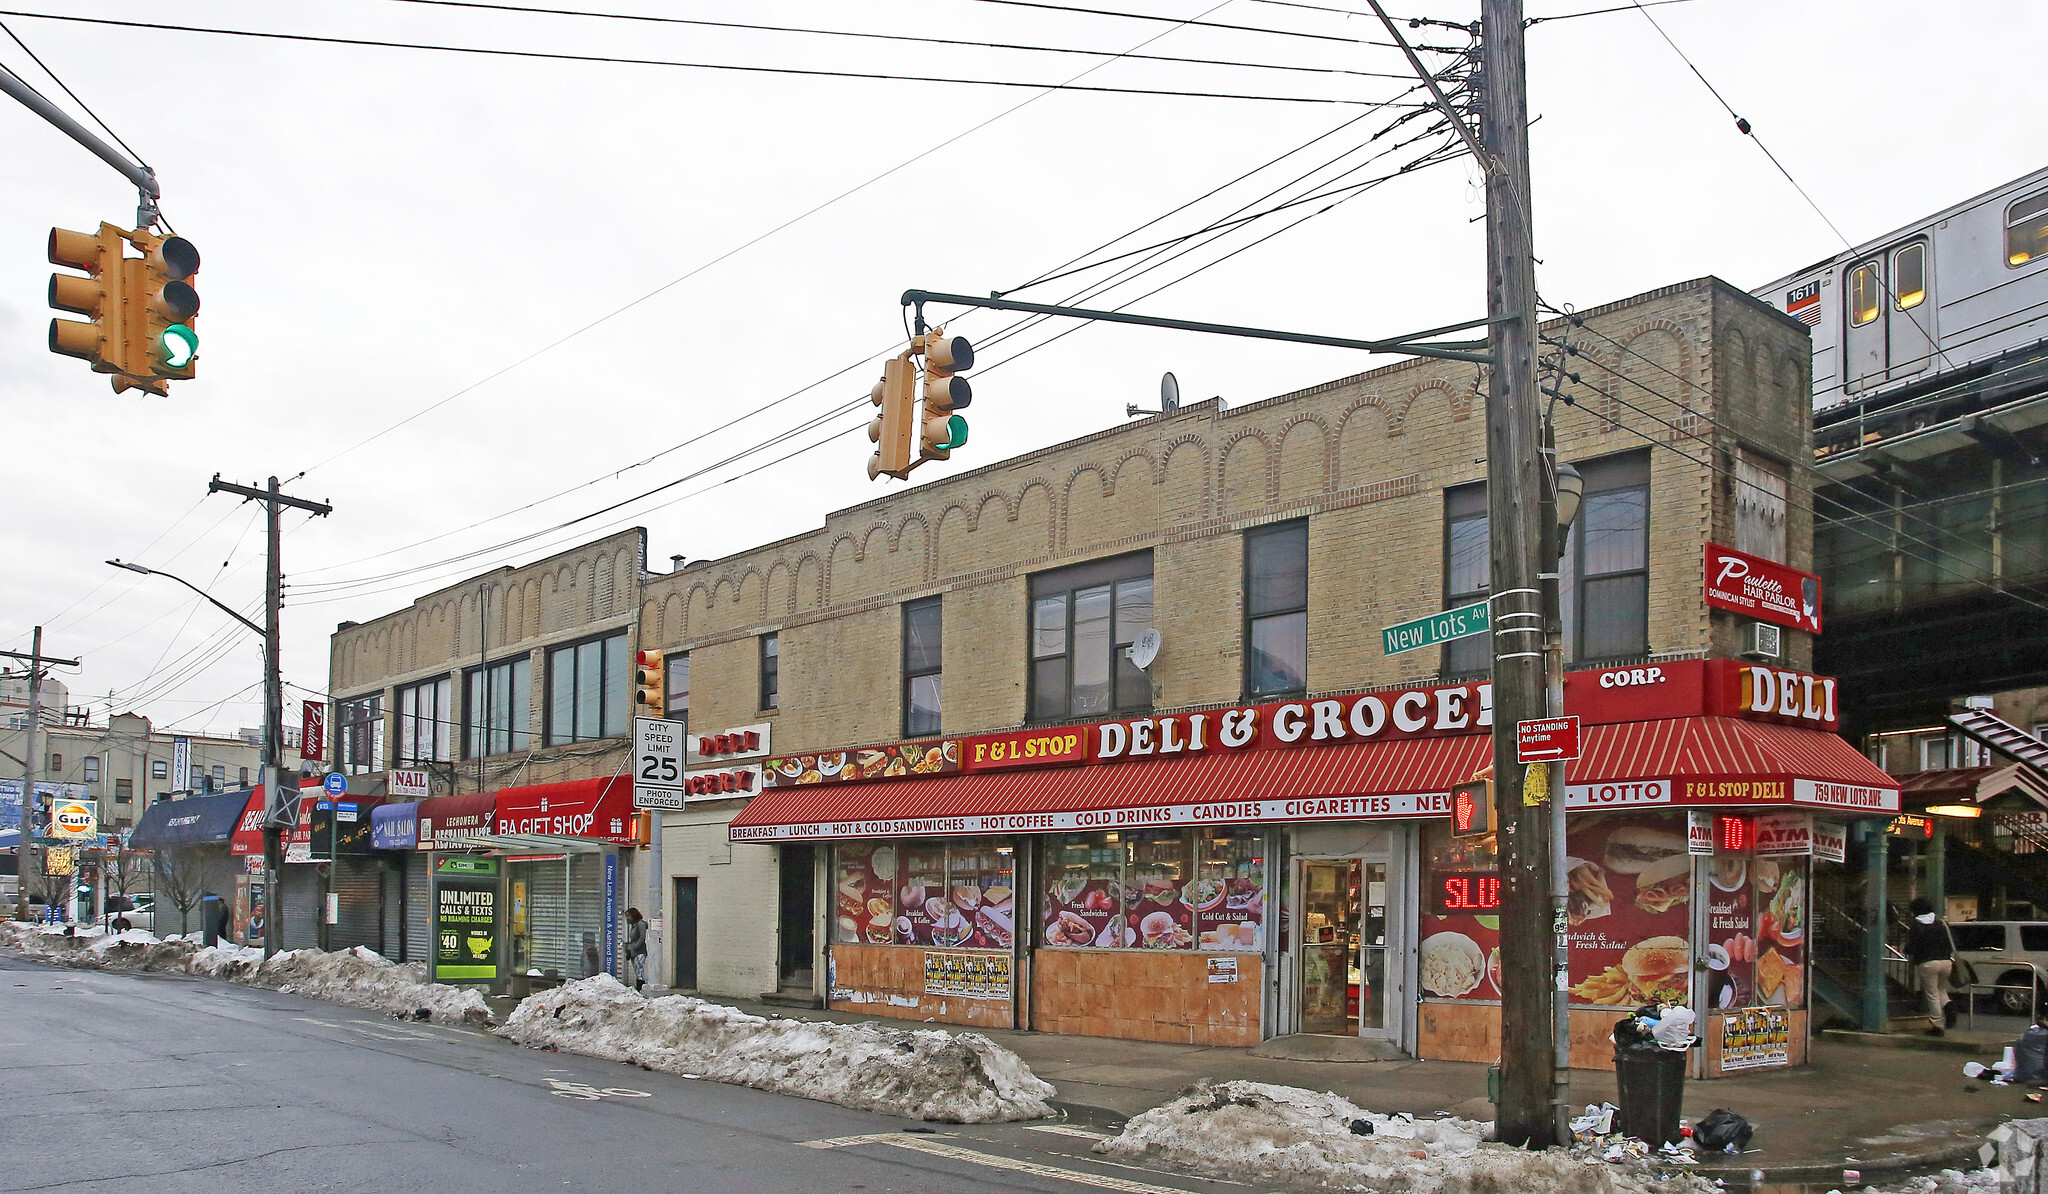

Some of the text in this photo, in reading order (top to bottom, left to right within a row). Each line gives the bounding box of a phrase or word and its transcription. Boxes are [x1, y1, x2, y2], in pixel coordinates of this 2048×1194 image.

[1790, 284, 1815, 302] 1611
[1716, 556, 1783, 594] Paulette
[1708, 587, 1756, 608] DOMINICAN STYLIST
[1743, 584, 1764, 601] HAIR
[1764, 590, 1796, 609] PARLOR
[1386, 625, 1424, 652] New
[1430, 614, 1467, 641] Lots
[1599, 666, 1666, 689] CORP.
[1750, 666, 1836, 722] DELI
[304, 702, 323, 756] Paulette
[648, 723, 669, 732] CITY
[1097, 714, 1207, 759] DELI
[1219, 708, 1255, 748] &
[1521, 722, 1569, 734] NO STANDING
[644, 733, 673, 743] SPEED
[699, 731, 760, 756] DELI
[1521, 733, 1551, 744] Anytime
[647, 743, 671, 753] LIMIT
[974, 734, 1078, 763] F & L STOP
[641, 755, 678, 781] 25
[395, 771, 426, 787] NAIL
[646, 789, 672, 799] PHOTO
[1588, 782, 1662, 803] LOTTO
[1686, 782, 1785, 799] F & L STOP DELI
[1814, 783, 1882, 807] 759 NEW LOTS AVE
[638, 796, 680, 807] ENFORCED
[59, 814, 91, 824] Gulf
[446, 815, 479, 827] LECHONERA
[499, 813, 594, 836] BA GIFT SHOP
[732, 827, 778, 839] BREAKFAST
[789, 824, 820, 836] LUNCH
[832, 823, 853, 834] HOT
[855, 823, 862, 833] &
[864, 821, 891, 833] COLD
[894, 818, 965, 832] SANDWICHES
[980, 816, 1005, 829] HOT
[1008, 815, 1054, 828] COFFEE
[1075, 811, 1111, 825] COLD
[1116, 807, 1171, 823] DRINKS
[1192, 802, 1261, 819] CANDIES
[1285, 797, 1390, 815] CIGARETTES
[383, 821, 396, 837] NAIL
[397, 819, 414, 837] SALON
[1690, 826, 1713, 841] ATM
[1757, 828, 1810, 843] ATM
[1813, 832, 1843, 850] ATM
[440, 890, 494, 906] UNLIMITED
[1071, 901, 1085, 910] Fresh
[464, 905, 470, 915] &
[471, 906, 493, 916] TEXTS
[905, 909, 924, 917] Breakfast
[1079, 908, 1108, 918] Sandwiches
[1709, 901, 1732, 914] reakfast
[470, 916, 493, 924] CHARGES
[1201, 911, 1248, 921] Cold Cut & Salad
[1719, 916, 1734, 929] Fresh
[1735, 916, 1749, 929] Salad
[441, 935, 457, 949] $40
[1567, 932, 1607, 941] ndwich &
[1575, 940, 1598, 949] Fresh
